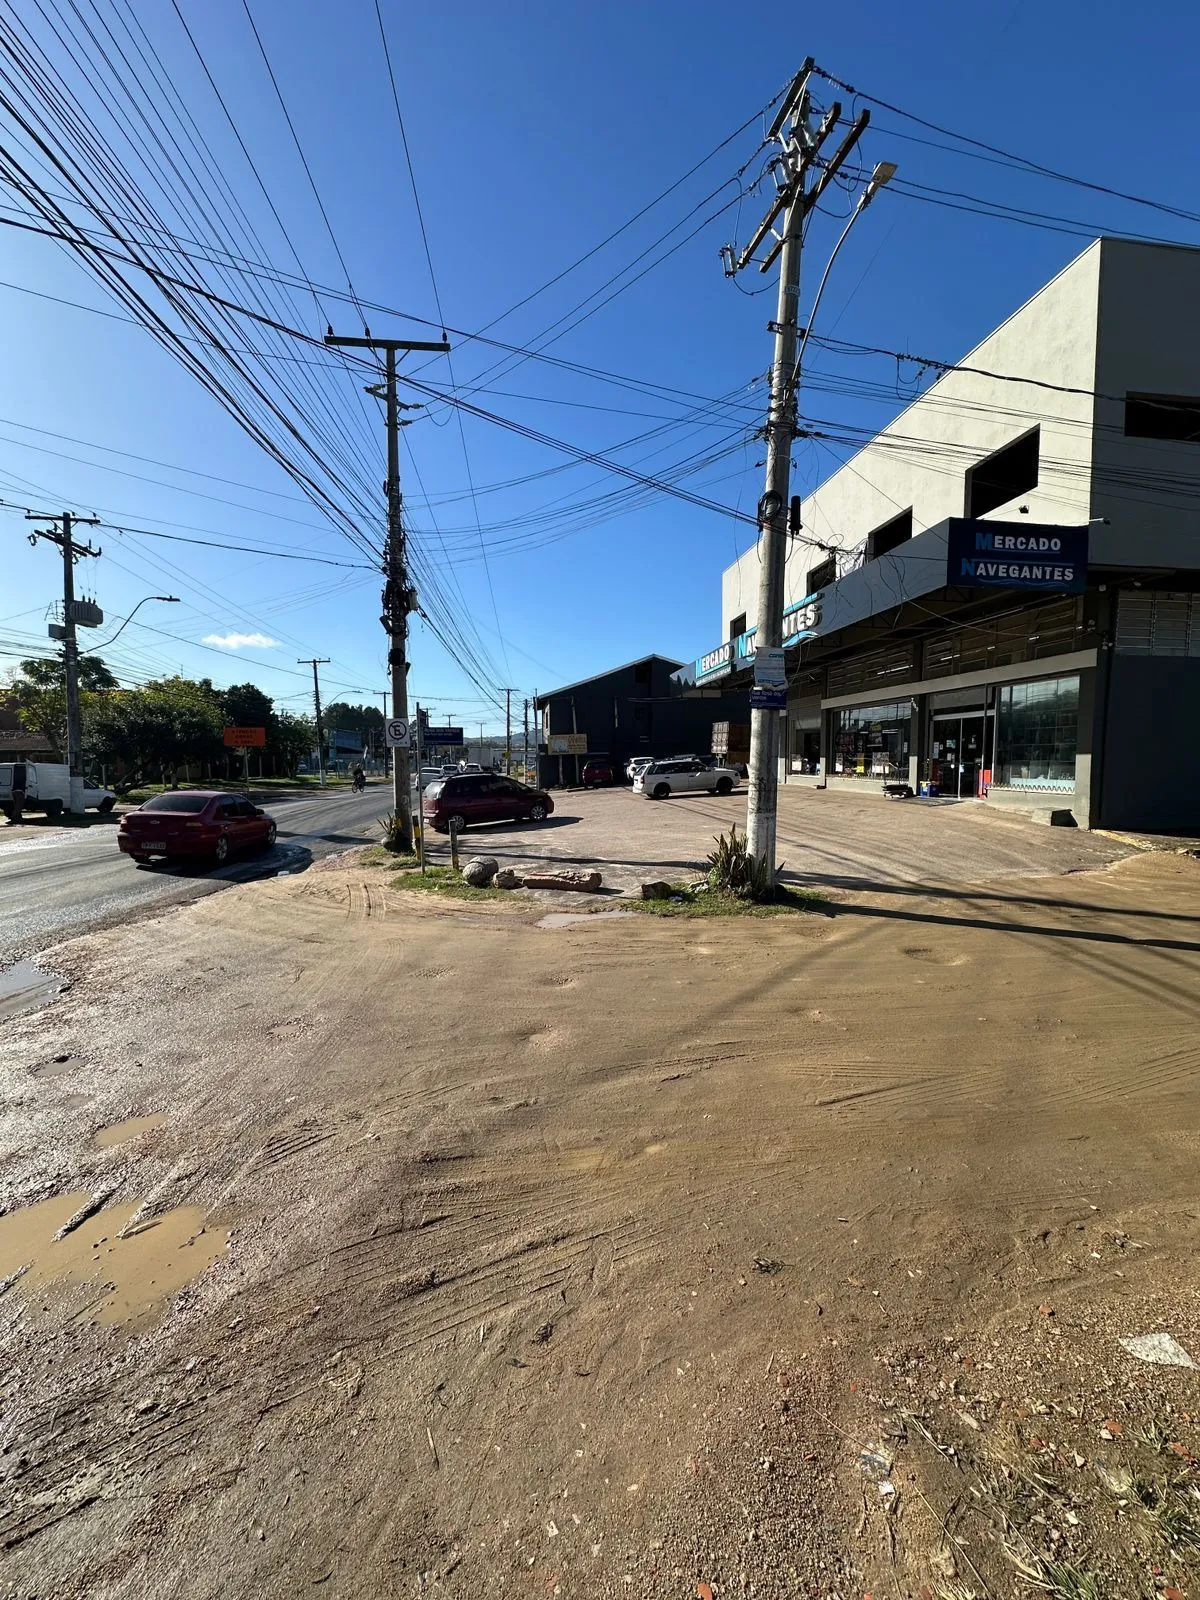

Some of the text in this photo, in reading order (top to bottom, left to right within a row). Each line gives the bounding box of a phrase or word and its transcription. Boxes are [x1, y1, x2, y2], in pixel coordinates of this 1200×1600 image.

[975, 532, 1062, 551] MERCADO
[960, 557, 1075, 581] NAVEGANTES
[695, 645, 731, 679] MERCADO
